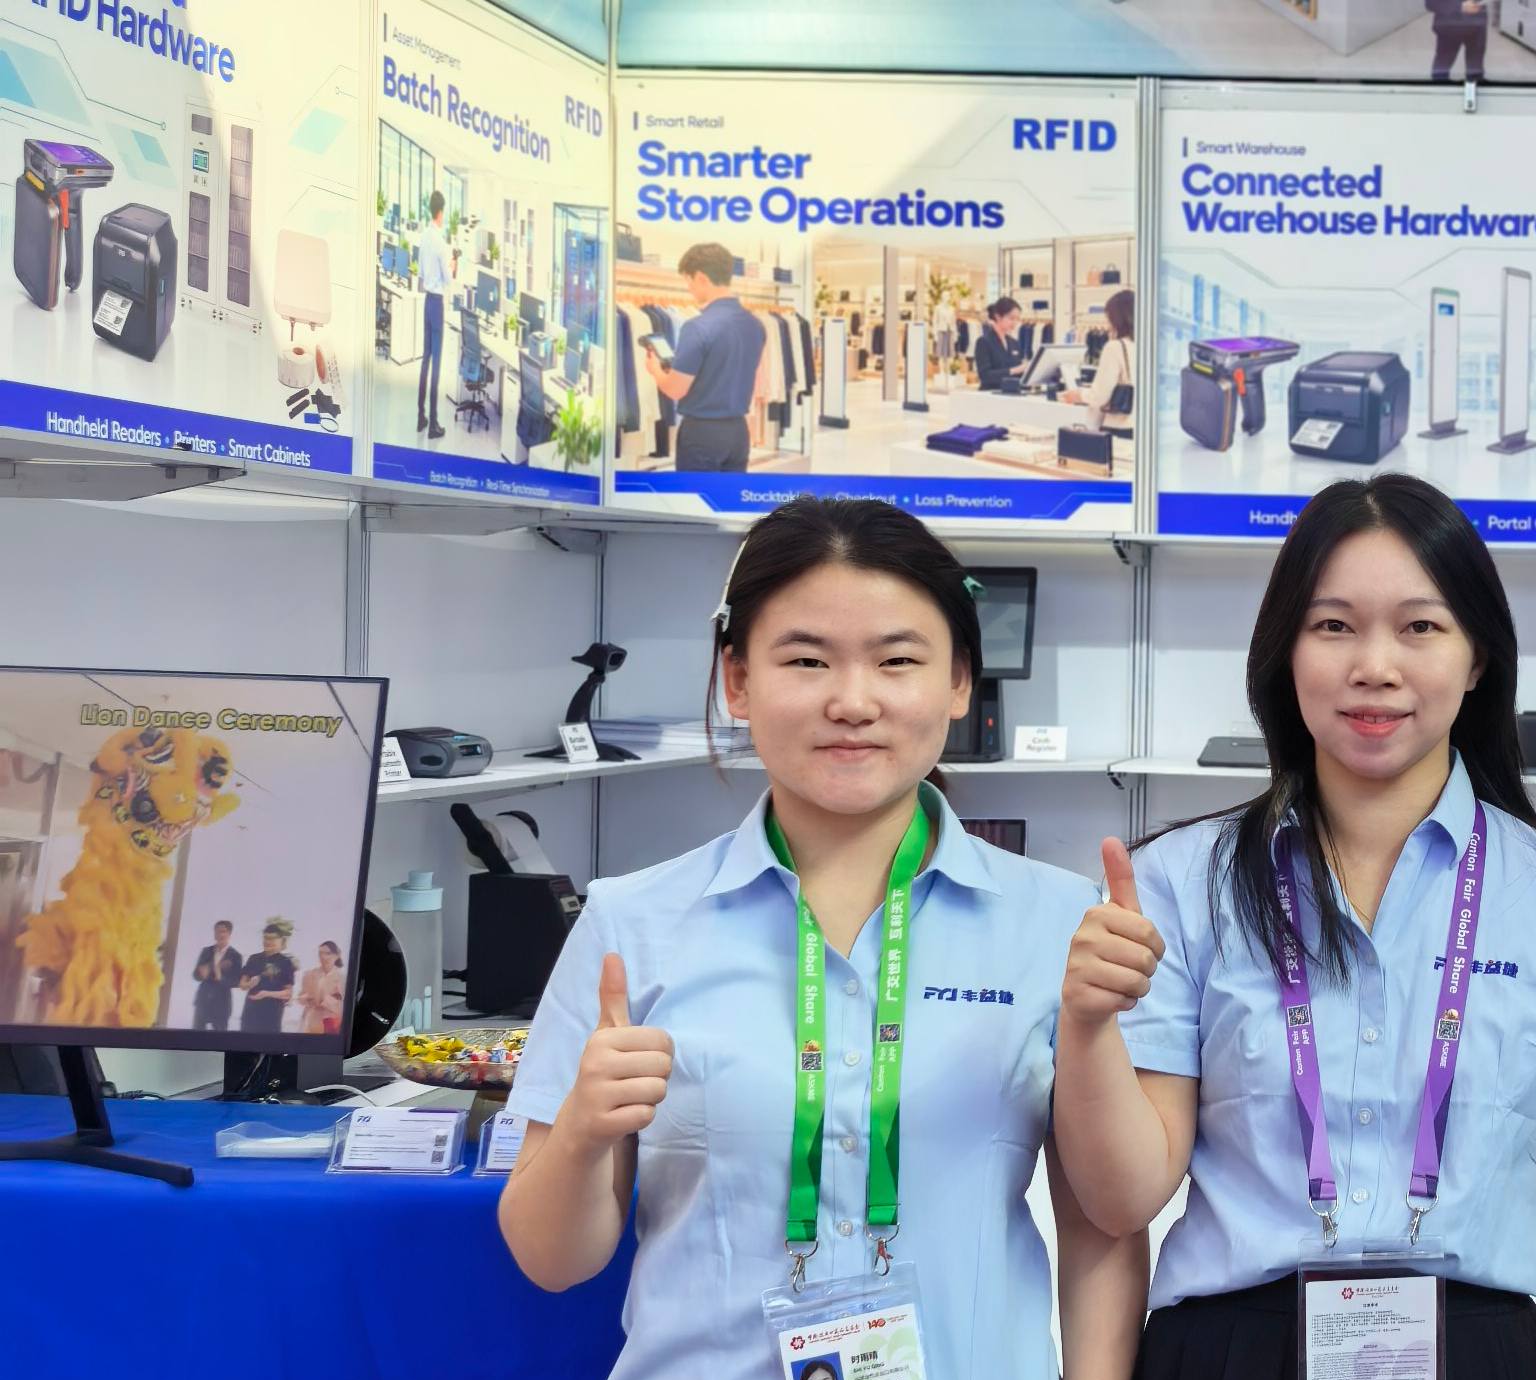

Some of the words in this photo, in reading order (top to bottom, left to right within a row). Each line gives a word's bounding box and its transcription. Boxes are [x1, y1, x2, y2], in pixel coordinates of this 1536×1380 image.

[97, 0, 236, 83] Hardware
[383, 55, 442, 119] Batch
[447, 84, 551, 164] Recognition
[565, 95, 603, 138] RFID
[645, 114, 684, 129] Smart
[688, 115, 725, 129] Retail
[1012, 117, 1118, 152] RFID
[1196, 141, 1233, 156] Smart
[1235, 142, 1306, 157] Warehouse
[637, 140, 811, 179] Smarter
[1182, 163, 1382, 199] Connected
[636, 184, 753, 222] Store
[759, 187, 1005, 232] Operations
[1182, 202, 1377, 236] Warehouse
[47, 411, 108, 439] Handheld
[112, 421, 161, 447] Readers
[229, 438, 262, 461] Smart
[264, 444, 311, 467] Cabinets
[915, 494, 943, 507] Loss
[946, 495, 1012, 508] Prevention
[1249, 510, 1299, 527] Handh
[1488, 515, 1531, 532] Portal
[80, 704, 127, 726] Lion
[133, 706, 212, 729] Dance
[217, 708, 343, 738] Ceremony
[1467, 832, 1481, 872] Canton
[1463, 879, 1476, 903] Fair
[1457, 908, 1472, 950] Global
[805, 932, 818, 977] Global
[1449, 956, 1465, 994] Share
[805, 984, 818, 1024] Share
